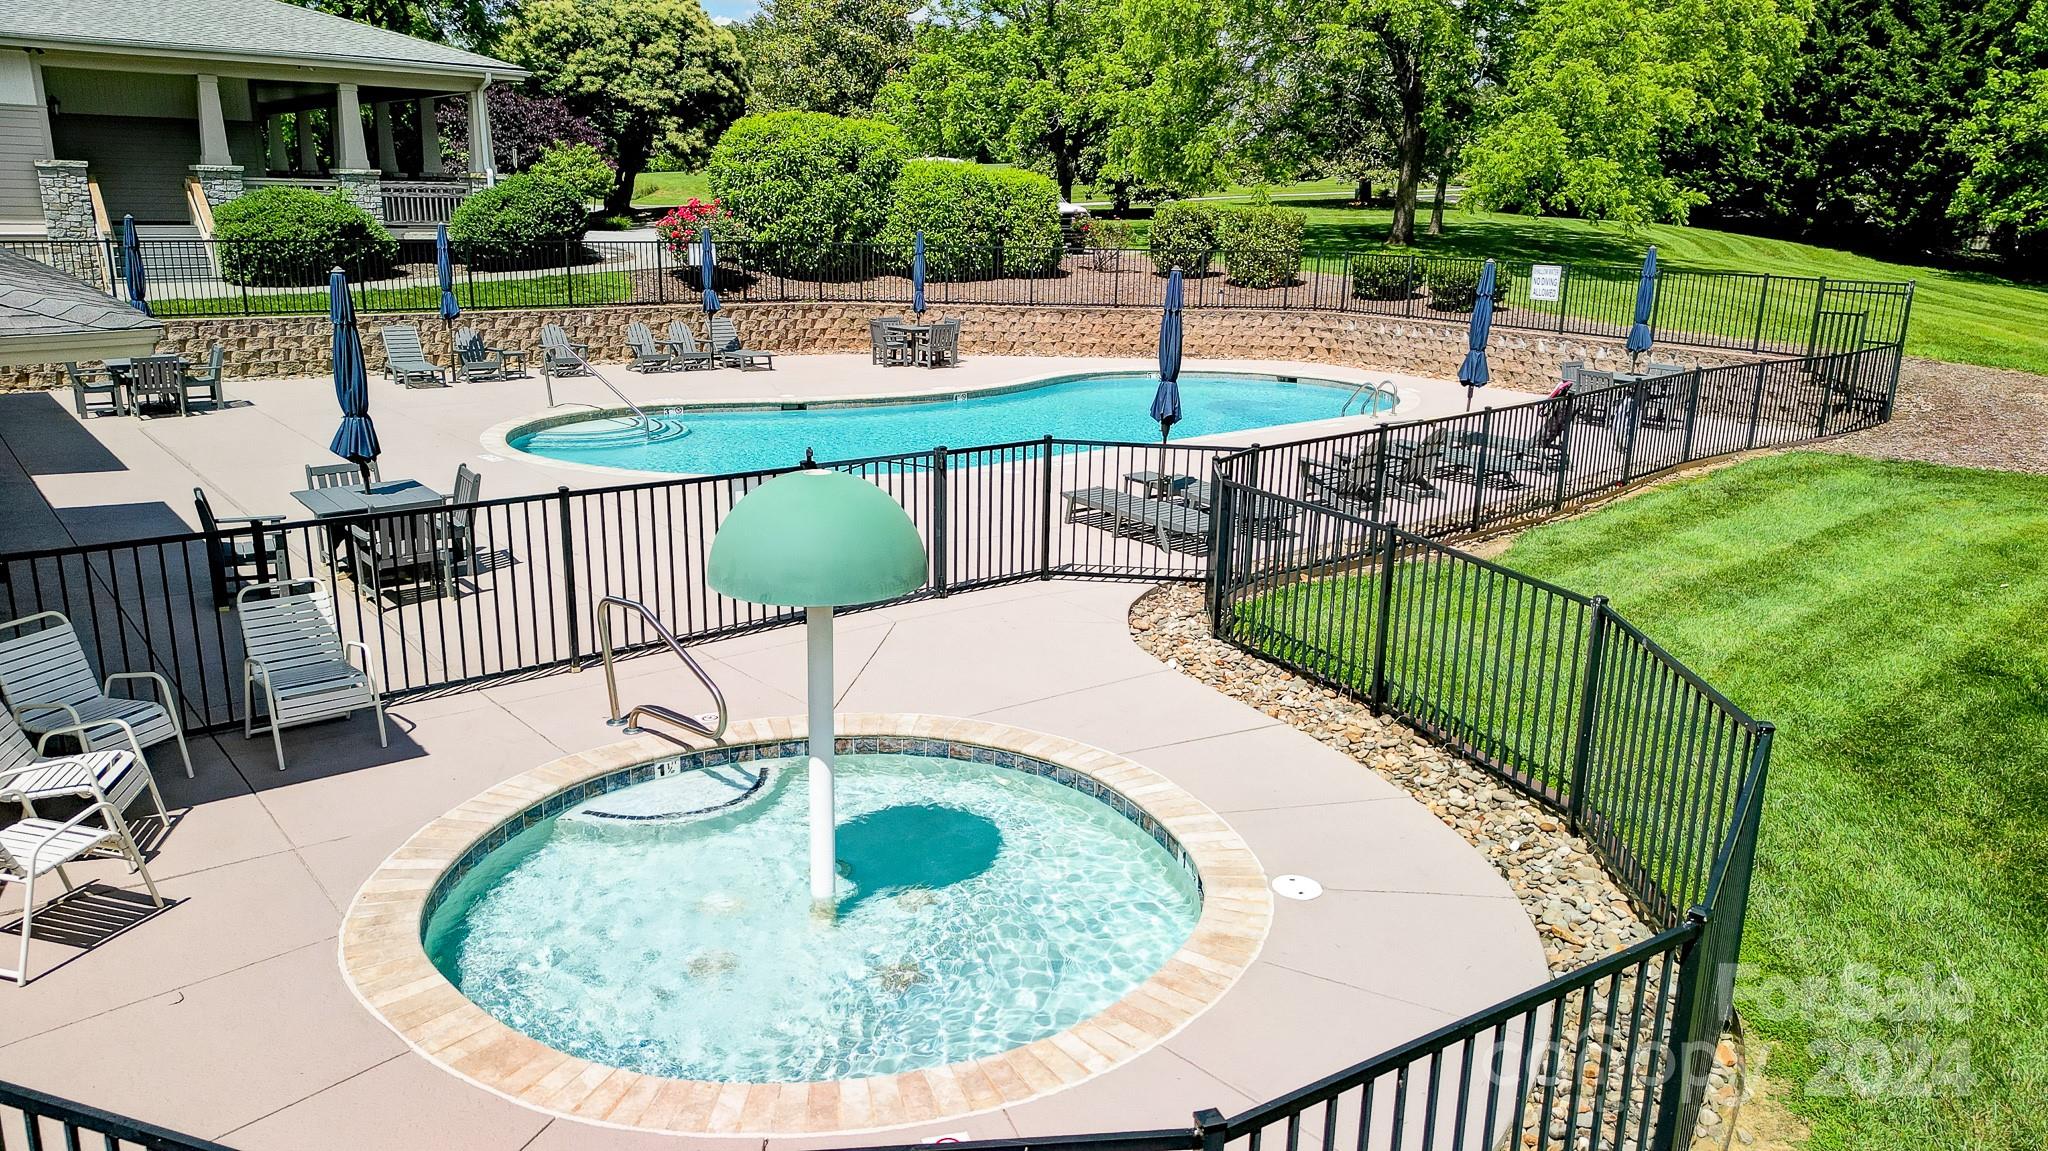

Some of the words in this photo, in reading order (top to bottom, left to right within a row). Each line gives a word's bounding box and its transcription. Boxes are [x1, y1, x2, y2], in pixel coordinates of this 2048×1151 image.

[1533, 277, 1540, 285] NO
[1541, 277, 1558, 287] DIVING
[1533, 288, 1556, 298] ALLOWED
